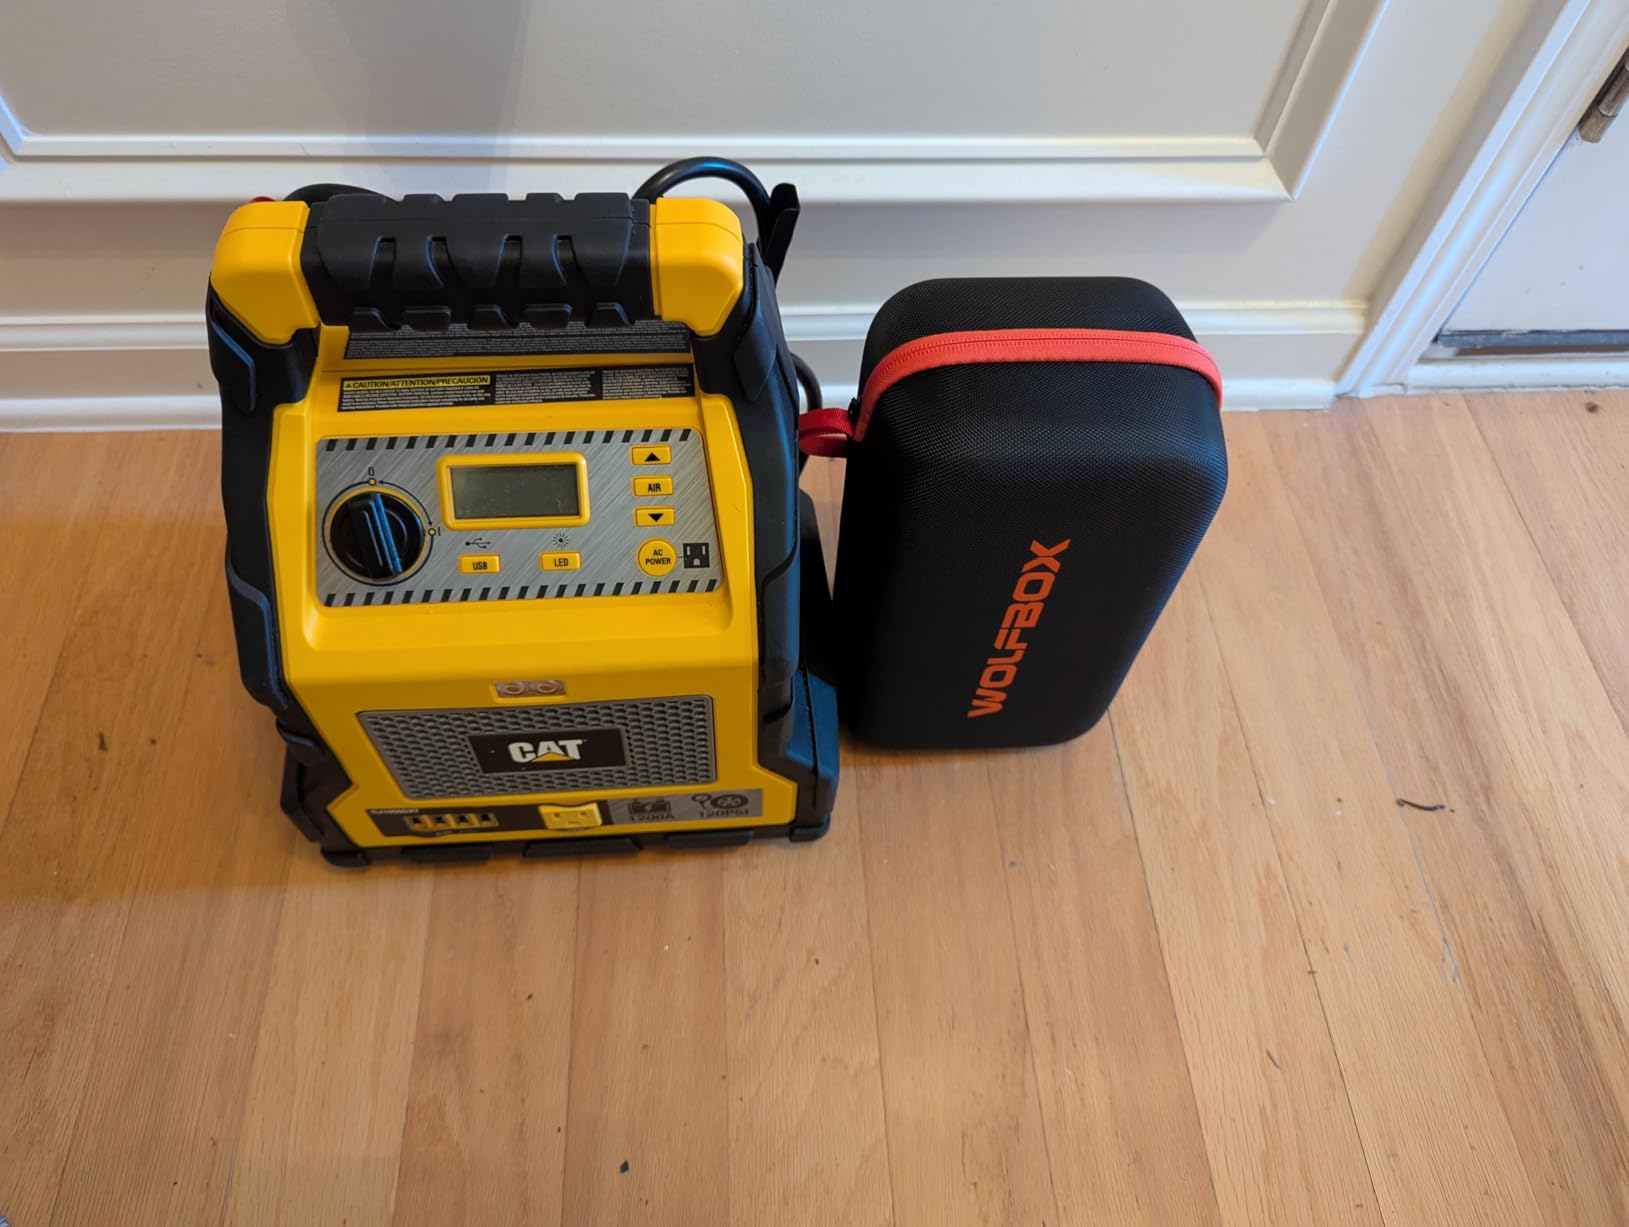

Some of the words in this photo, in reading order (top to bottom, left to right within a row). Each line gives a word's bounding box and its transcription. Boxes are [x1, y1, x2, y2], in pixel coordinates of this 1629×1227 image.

[647, 482, 662, 493] AIR
[653, 548, 664, 556] AC
[472, 561, 488, 570] USB
[553, 557, 569, 567] LED
[645, 557, 671, 566] POWER
[967, 538, 1071, 718] WOLFBOX
[508, 739, 583, 763] CAT
